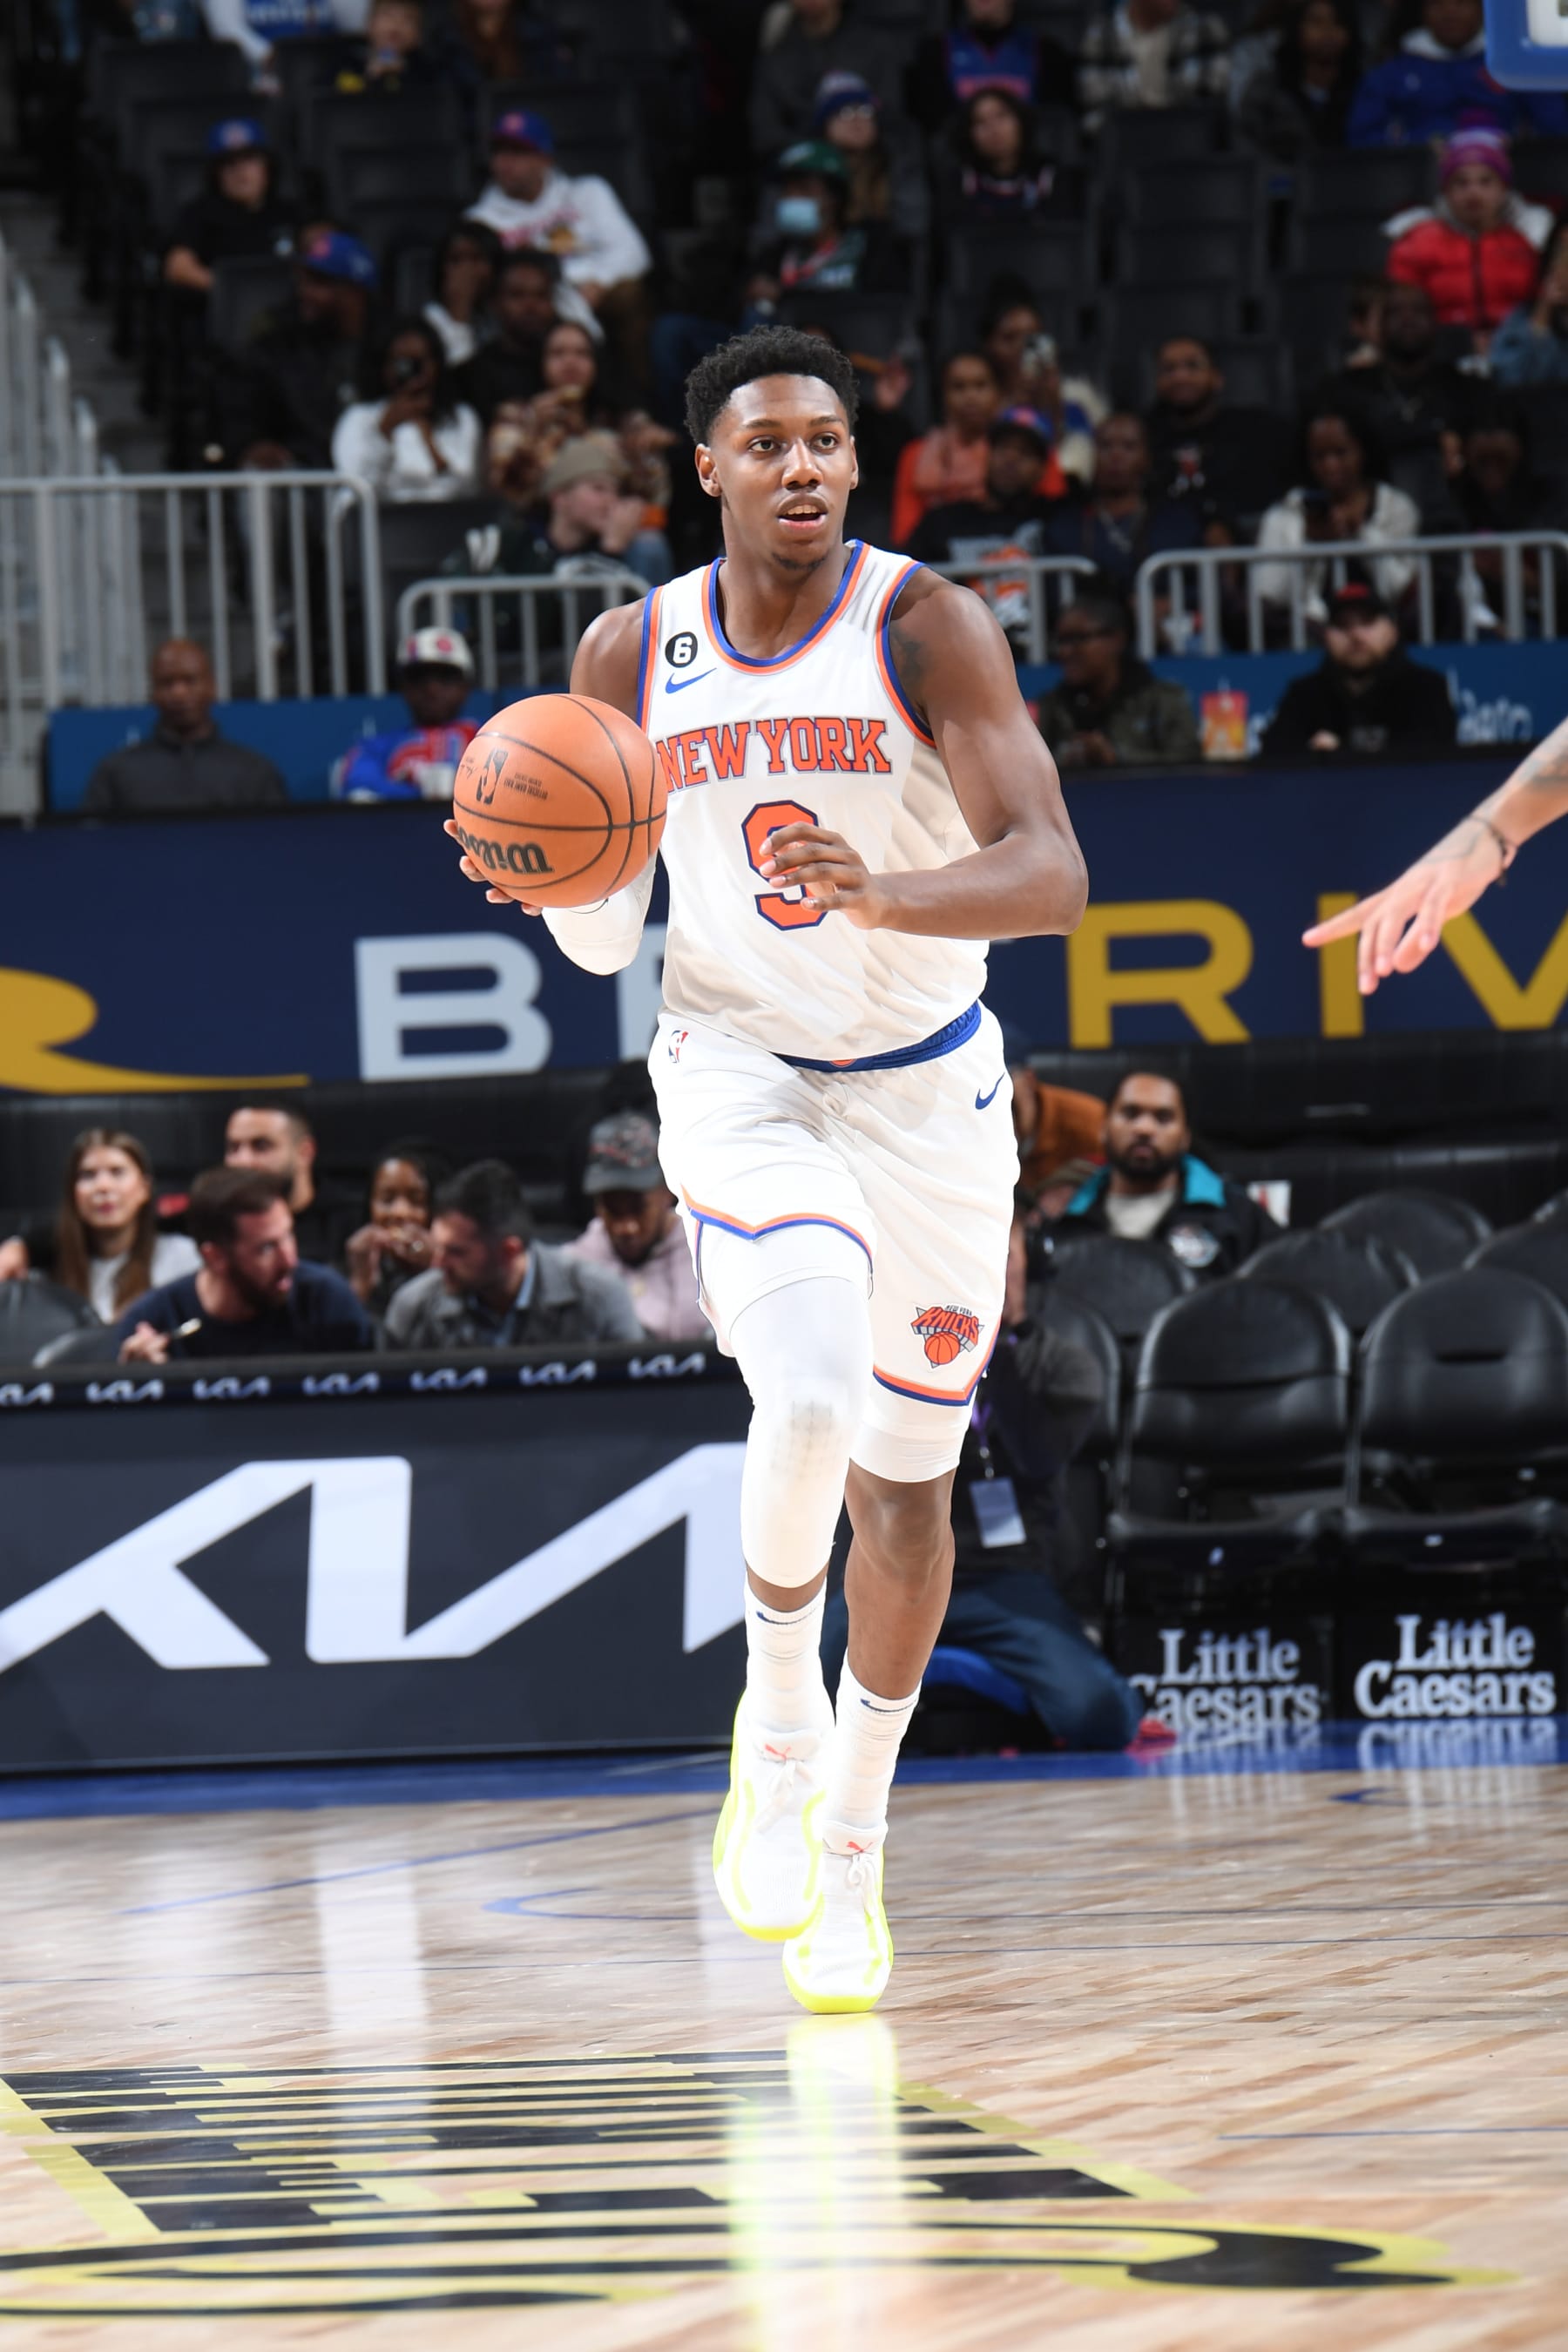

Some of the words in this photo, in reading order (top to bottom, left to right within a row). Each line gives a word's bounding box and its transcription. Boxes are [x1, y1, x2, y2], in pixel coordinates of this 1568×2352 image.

[672, 635, 693, 666] 6
[655, 721, 752, 794] NEW
[755, 716, 893, 775] YORK
[910, 1306, 978, 1347] KNICKS
[1159, 1628, 1300, 1684] Little
[1396, 1612, 1535, 1670] Little
[1355, 1660, 1557, 1717] Caesars
